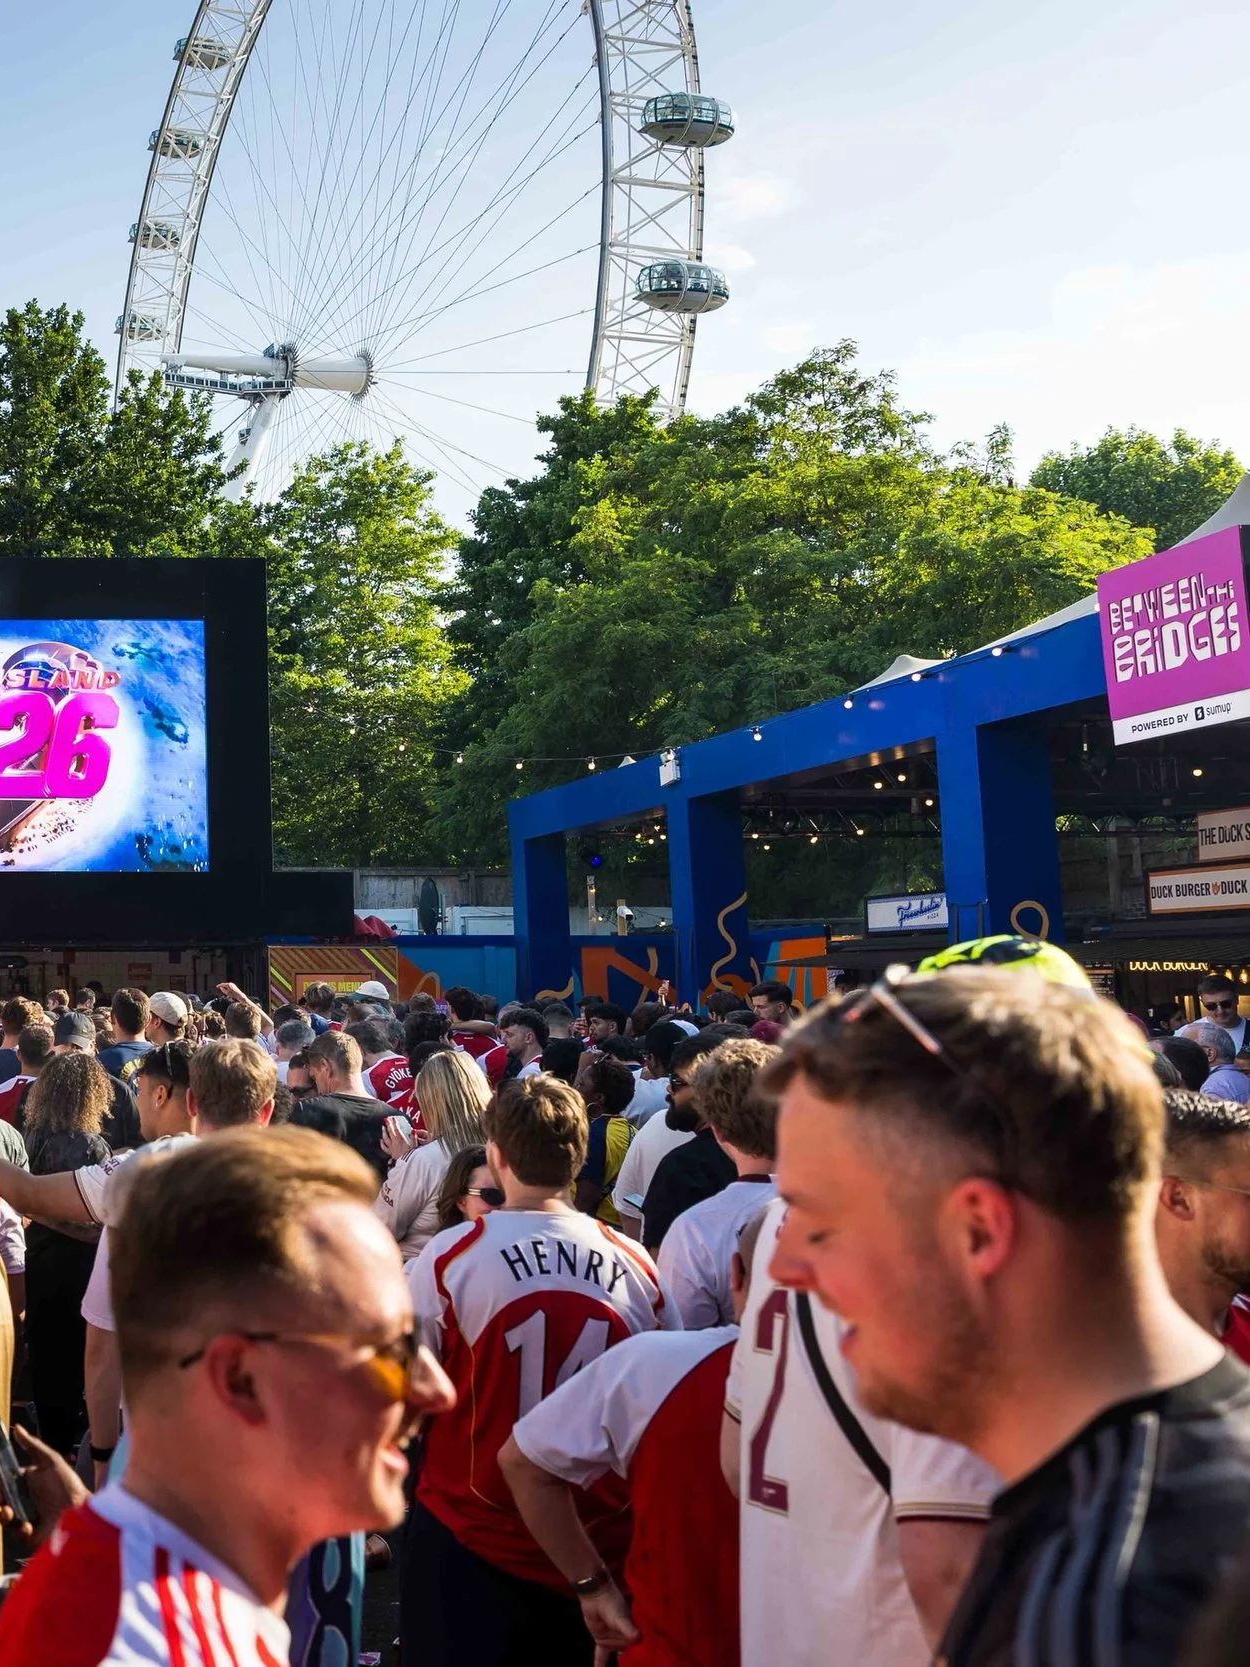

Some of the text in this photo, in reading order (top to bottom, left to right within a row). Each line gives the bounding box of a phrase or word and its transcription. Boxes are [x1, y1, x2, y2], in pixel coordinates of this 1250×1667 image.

[1108, 572, 1207, 635] BETWEEN
[1131, 715, 1175, 734] POWERED
[1176, 712, 1189, 724] BY
[1199, 826, 1217, 847] THE
[1218, 823, 1243, 844] DUCK
[1150, 879, 1248, 900] DUCK BURGER DUCK
[500, 1240, 628, 1294] HENRY
